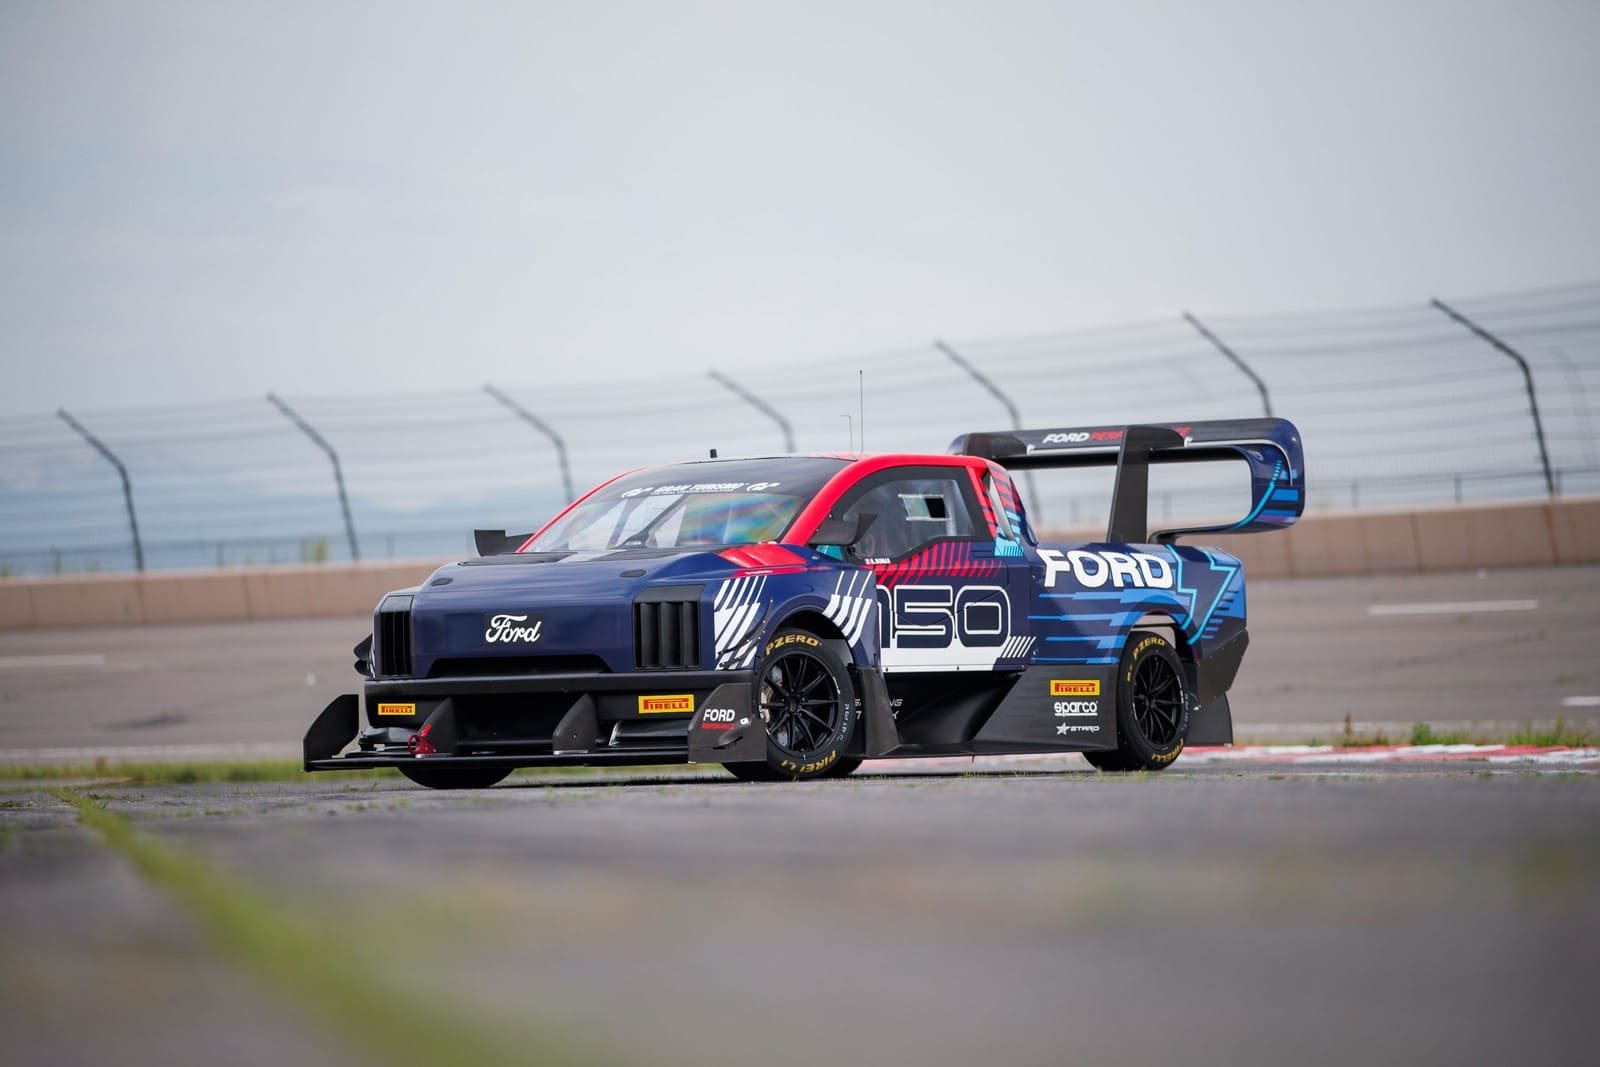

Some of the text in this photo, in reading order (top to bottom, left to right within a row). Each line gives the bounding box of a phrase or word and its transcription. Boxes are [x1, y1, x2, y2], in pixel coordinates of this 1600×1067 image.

[1042, 432, 1089, 444] FORD
[1036, 549, 1173, 588] FORD
[485, 614, 542, 643] Ford
[1054, 682, 1096, 693] PIRELLI
[381, 705, 412, 713] PIRELLI
[643, 697, 689, 710] PIRELLI
[1053, 701, 1098, 717] sparco
[702, 708, 736, 722] FORD
